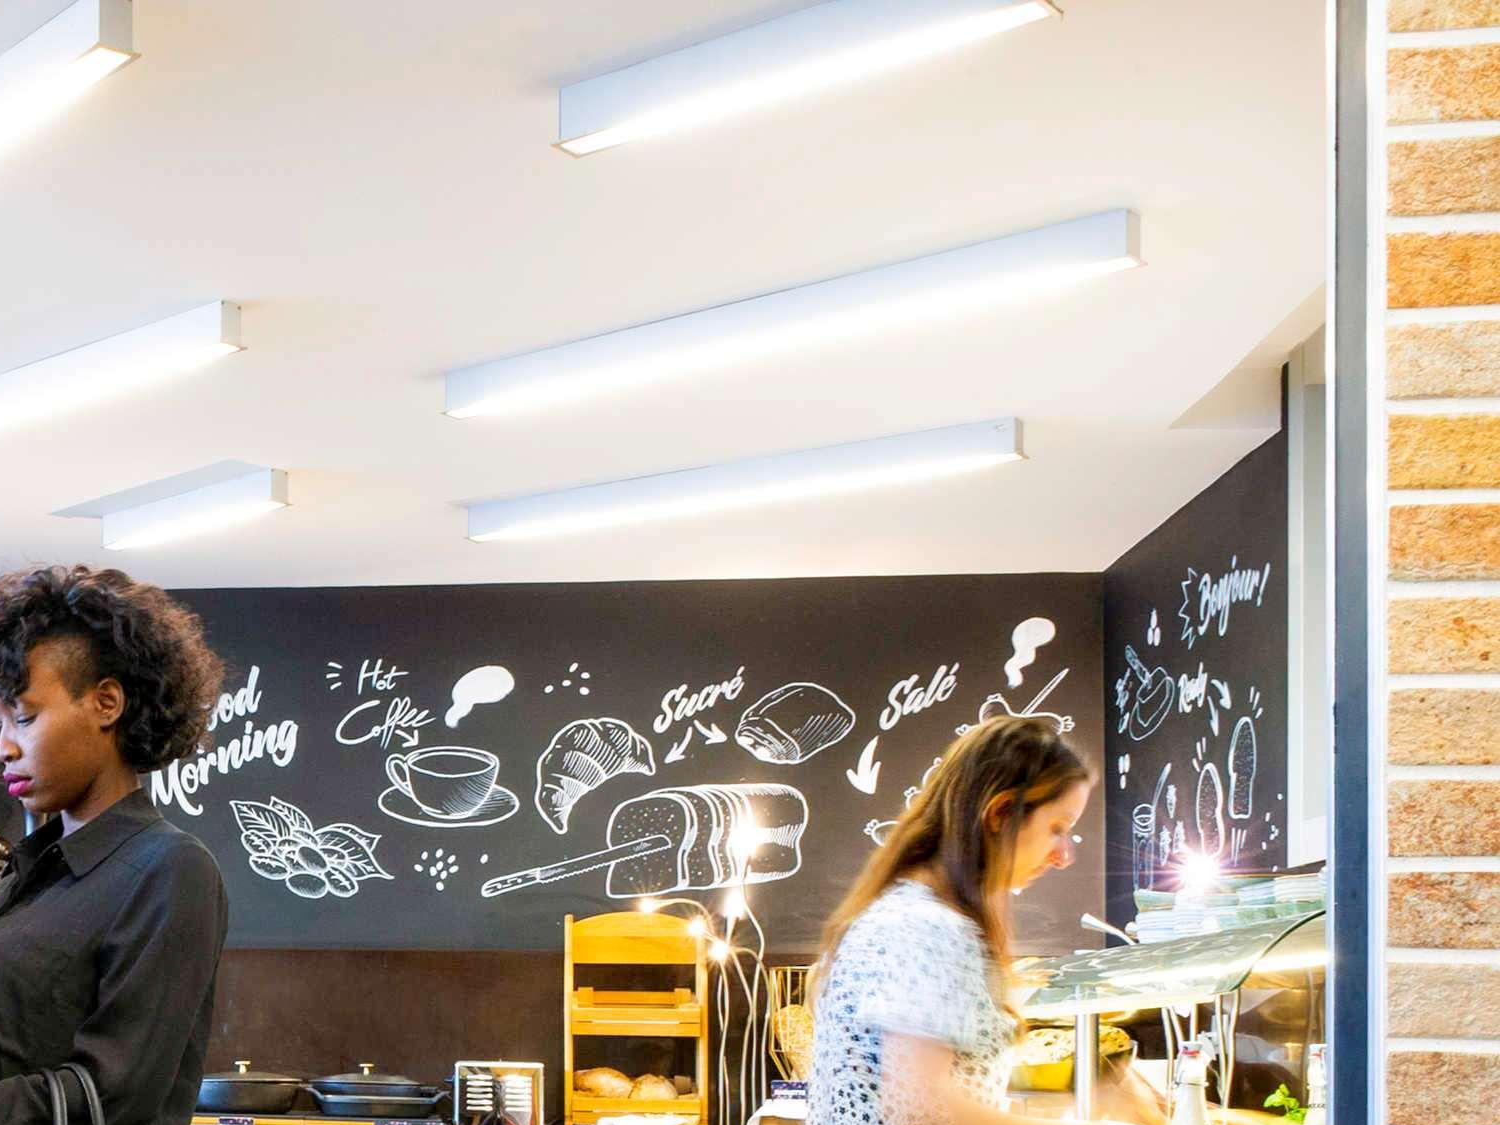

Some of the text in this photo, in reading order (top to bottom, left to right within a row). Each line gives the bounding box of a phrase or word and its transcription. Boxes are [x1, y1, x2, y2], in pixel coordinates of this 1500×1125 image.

[1198, 554, 1271, 637] Bonjour!
[357, 658, 409, 695] Hot
[653, 665, 745, 734] Sucré
[879, 662, 960, 731] Salé
[336, 696, 437, 750] Coffee
[150, 719, 299, 816] Morning
